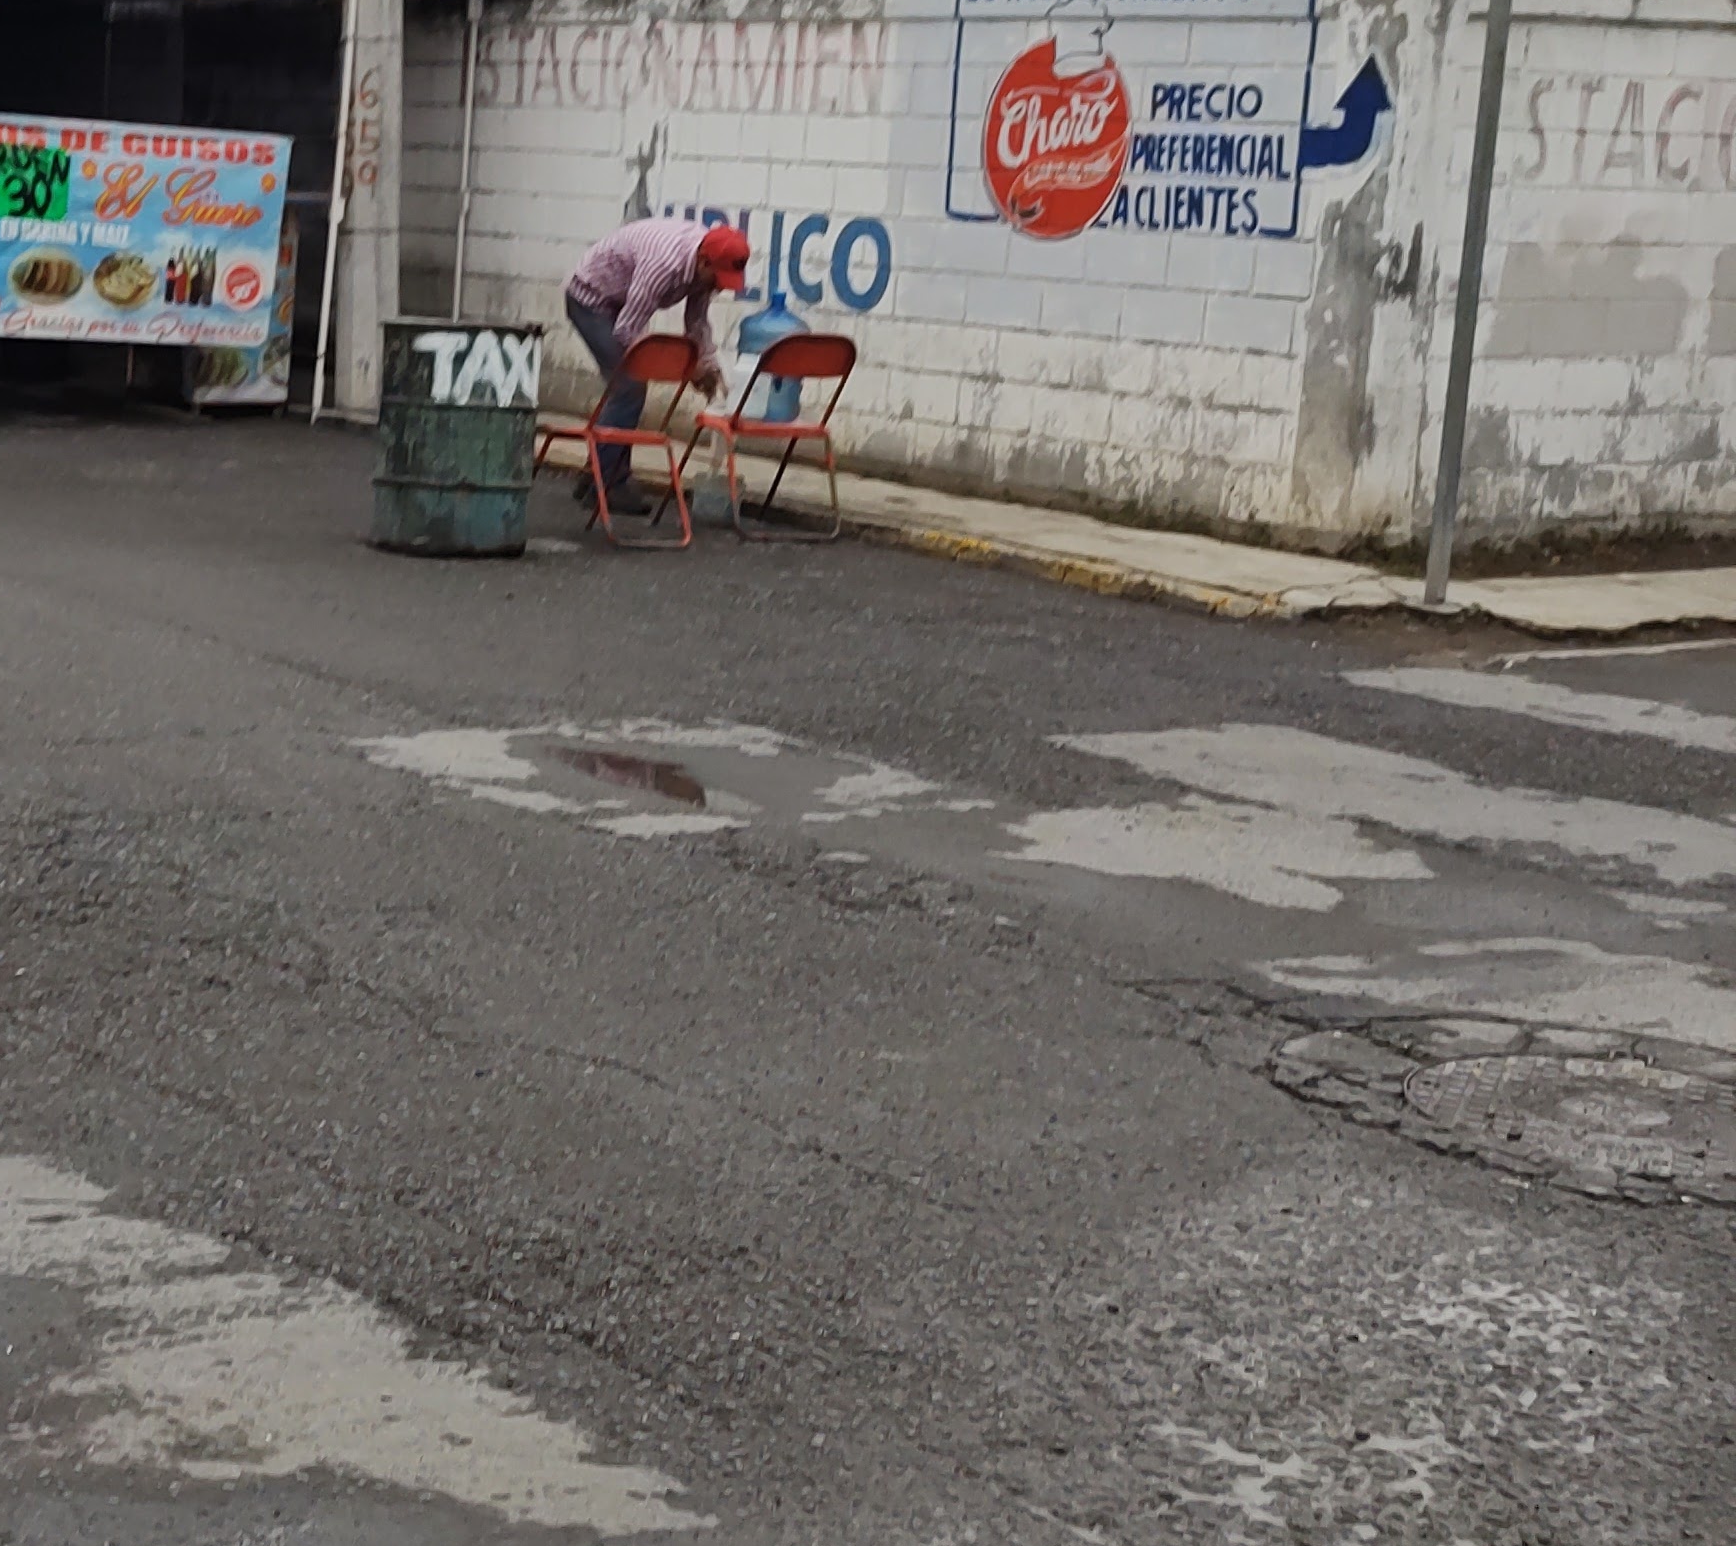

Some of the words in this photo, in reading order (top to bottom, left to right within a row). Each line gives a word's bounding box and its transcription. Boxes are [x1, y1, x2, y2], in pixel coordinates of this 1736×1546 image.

[1150, 83, 1263, 122] PRECIO
[60, 130, 112, 154] DE
[122, 133, 276, 166] GUISOS
[1130, 132, 1292, 181] PREFERENCIAL
[3, 168, 53, 220] 30
[95, 162, 160, 222] El
[1111, 185, 1130, 228] A
[1133, 185, 1261, 235] CLIENTES
